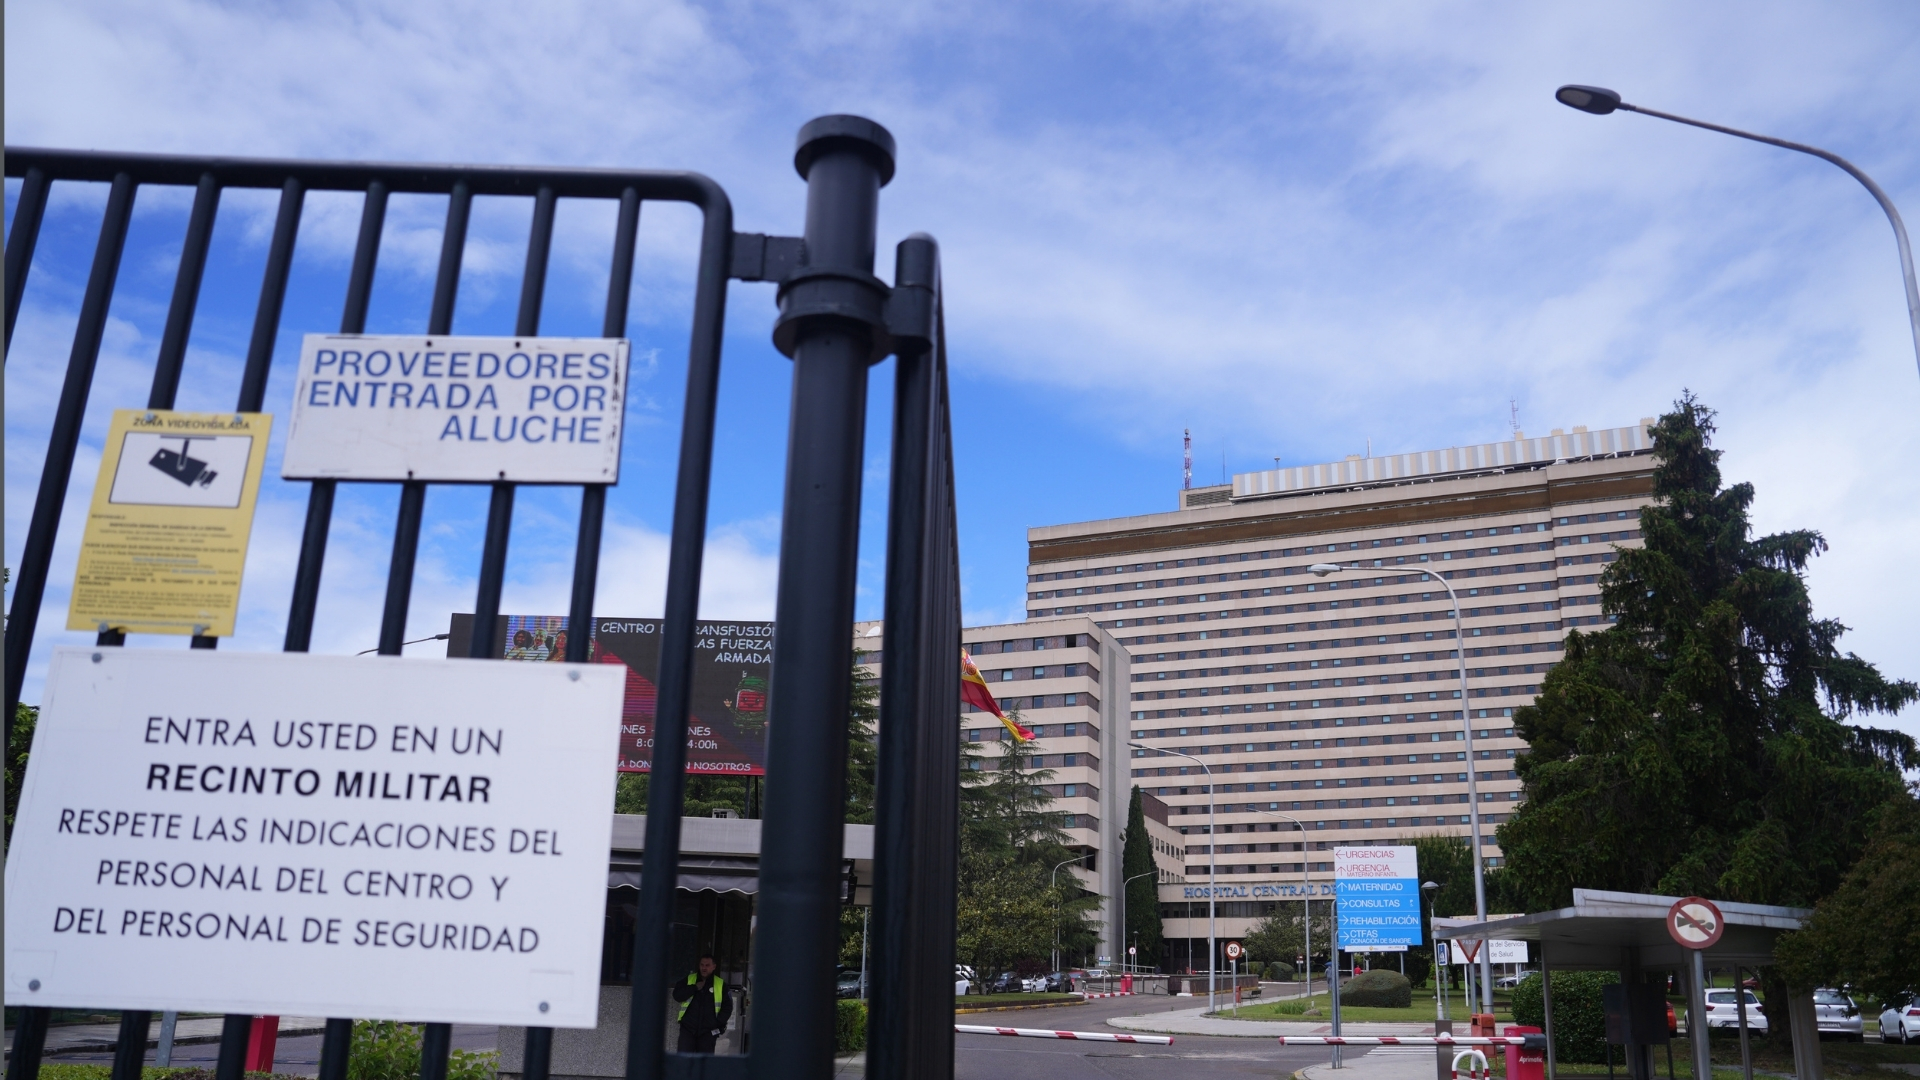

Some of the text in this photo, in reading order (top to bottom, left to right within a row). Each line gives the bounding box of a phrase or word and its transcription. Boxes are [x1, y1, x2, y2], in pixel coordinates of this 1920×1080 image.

[313, 349, 611, 380] PROVEEDORES
[308, 381, 607, 412] ENTRADA POR
[133, 417, 250, 430] ZONA VIDEOVIGILADA
[439, 415, 603, 443] ALUCHE
[601, 622, 655, 634] CENTRO
[696, 623, 775, 637] RANSFUSIÓ
[694, 638, 775, 650] AS FUERZA
[714, 652, 774, 664] ARMADA
[620, 724, 646, 735] NES
[144, 716, 502, 756] ENTRA USTED EN UN
[636, 738, 718, 749] 8:0 4:00h
[629, 760, 652, 768] DON
[693, 762, 751, 771] NOSOTROS
[146, 763, 492, 803] RECINTO MILITAR
[58, 808, 563, 856] RESPETE LAS INDICACIONES DEL
[1345, 850, 1395, 859] URGENCIAS
[1346, 864, 1391, 872] URGENCIA
[97, 860, 509, 902] PERSONAL DEL CENTRO Y
[1347, 883, 1404, 891] MATERNIDAD
[1184, 886, 1249, 898] HOSPITAL
[1252, 884, 1317, 897] CENTRAL
[1348, 899, 1401, 908] CONSULTAS
[1349, 914, 1419, 925] REHABILITACIÓN
[54, 907, 540, 953] DEL PERSONAL DE SEGURIDAD
[1350, 930, 1378, 938] CTFAS
[1229, 946, 1238, 954] 30
[1518, 1056, 1543, 1064] Aprimatic
